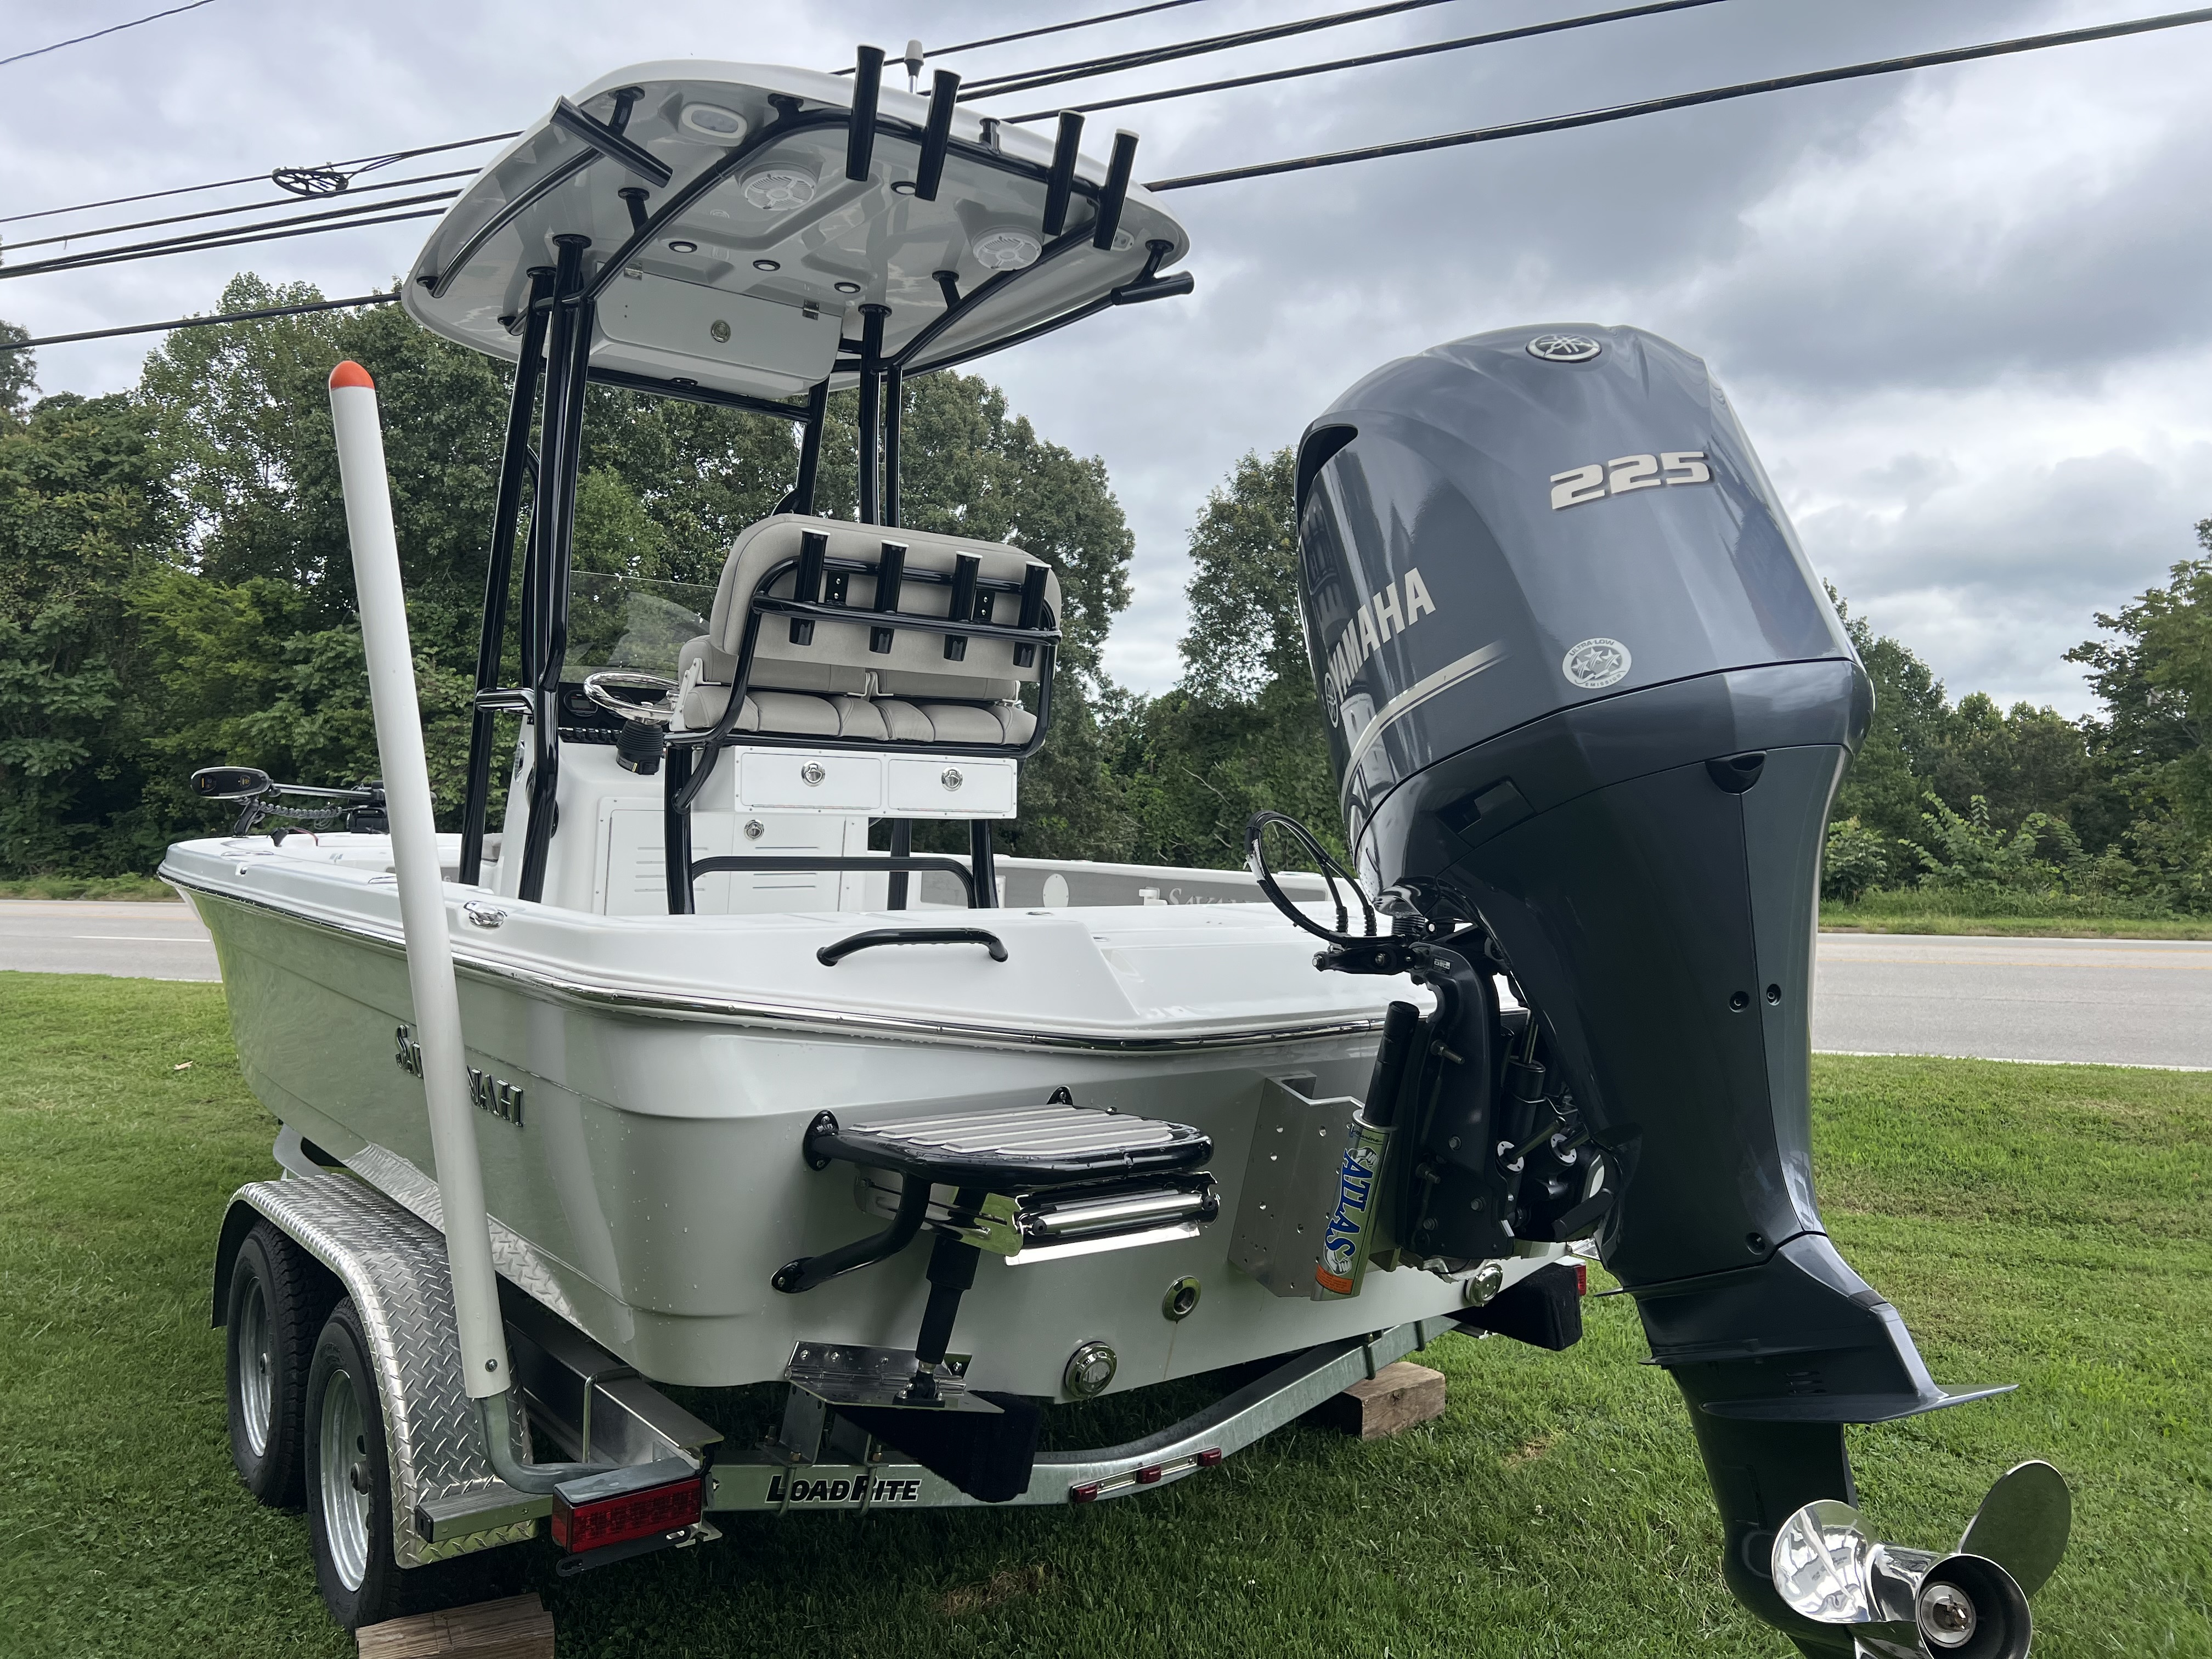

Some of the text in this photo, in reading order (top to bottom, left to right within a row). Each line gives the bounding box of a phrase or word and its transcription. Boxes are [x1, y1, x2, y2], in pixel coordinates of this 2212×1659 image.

[1550, 451, 1711, 510] 225
[1330, 567, 1436, 704] YAMAHA
[1585, 673, 1622, 687] EMISSION
[395, 1024, 524, 1127] SANAH
[1324, 1148, 1374, 1258] ATLAS
